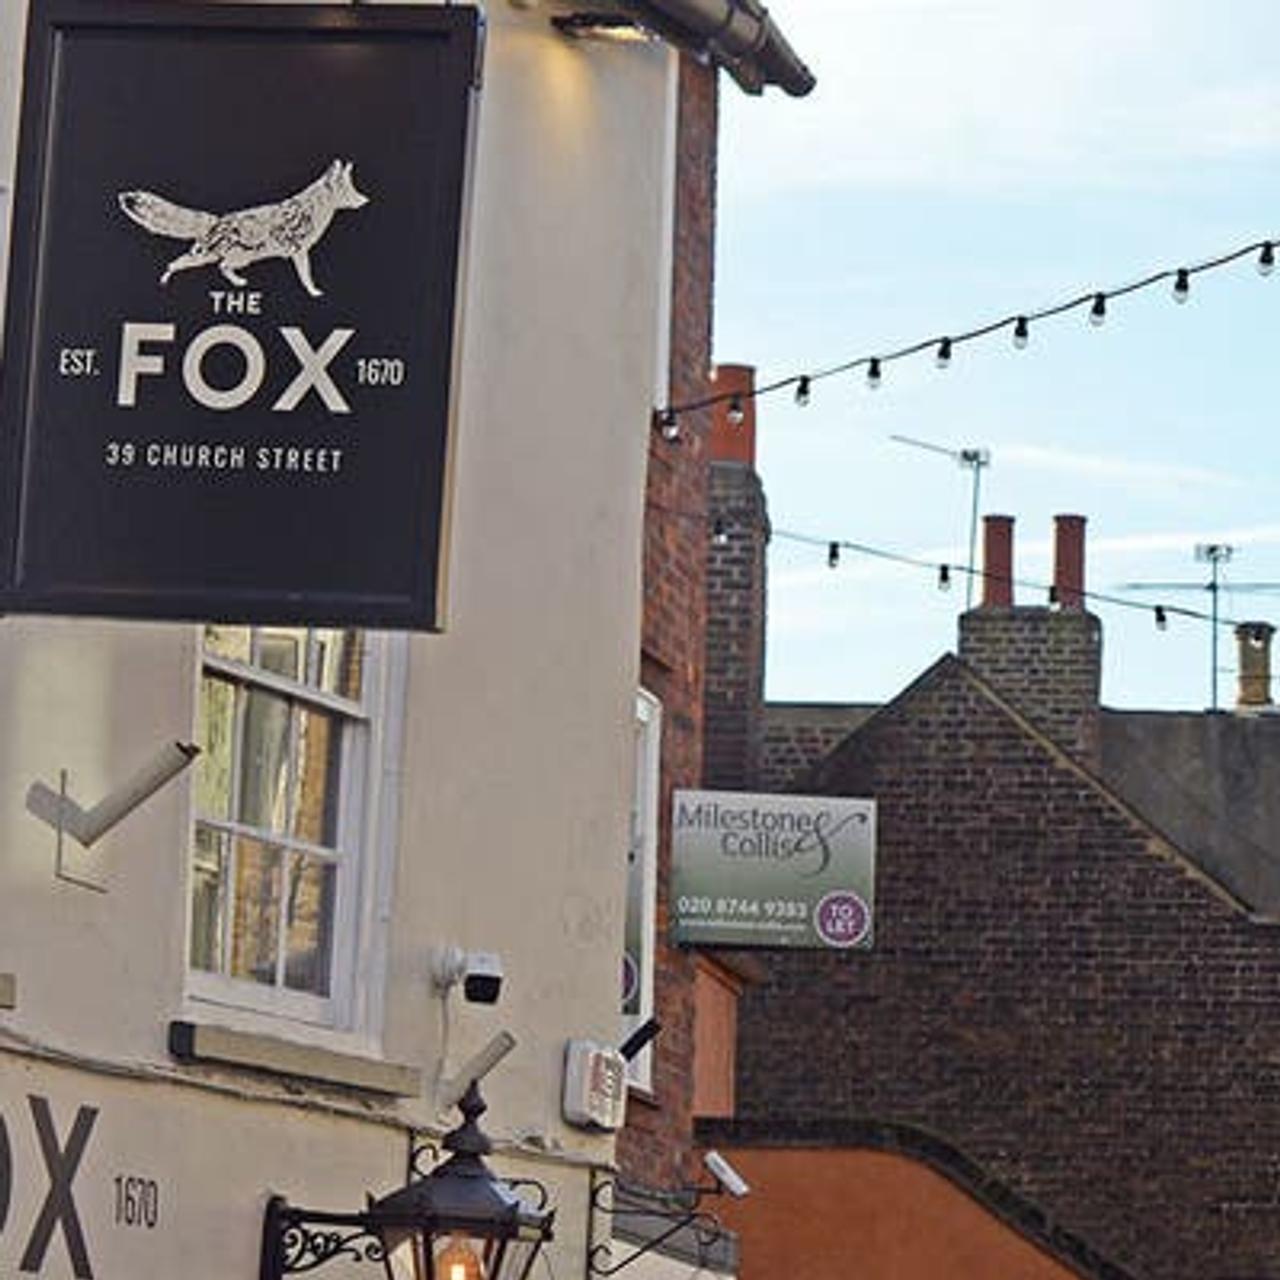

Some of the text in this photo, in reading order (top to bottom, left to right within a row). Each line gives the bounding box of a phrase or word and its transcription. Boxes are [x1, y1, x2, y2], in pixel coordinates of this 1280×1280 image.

[210, 291, 261, 314] THE
[60, 321, 403, 414] EST. FOX 1670
[106, 442, 342, 472] 39 CHURCH STREET
[677, 897, 711, 914] 020
[830, 903, 853, 918] TO
[825, 919, 856, 934] LET
[0, 1094, 158, 1280] X 1670
